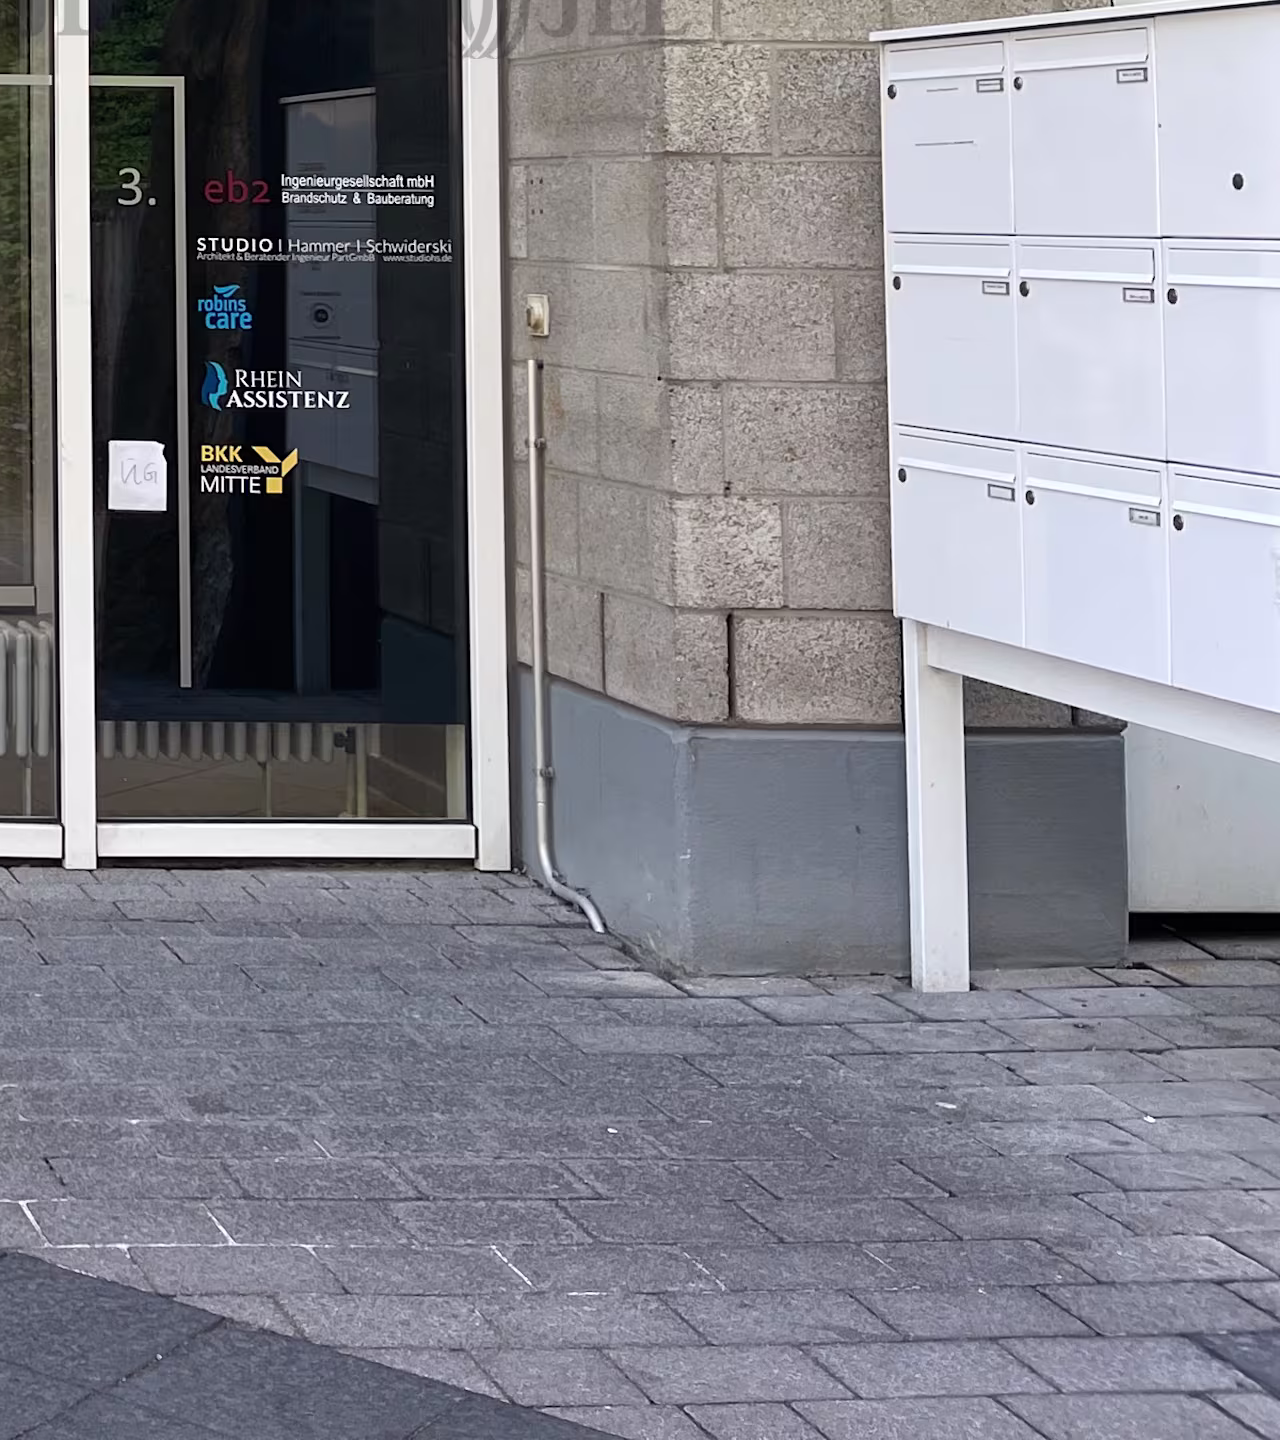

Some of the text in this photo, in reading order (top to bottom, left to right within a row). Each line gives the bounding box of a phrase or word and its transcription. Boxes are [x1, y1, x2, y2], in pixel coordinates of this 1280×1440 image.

[117, 166, 157, 207] 3.
[203, 170, 271, 204] eb2
[280, 173, 435, 190] Ingenieurgesellschaft mbH
[281, 192, 435, 208] Brandschutz & Bauberatung
[196, 237, 273, 253] STUDIO
[288, 238, 350, 253] Hammer
[365, 238, 453, 254] Schwiderski
[196, 253, 235, 262] Architekt
[197, 295, 247, 312] robins
[205, 311, 253, 330] care
[235, 368, 302, 389] RHEIN
[225, 389, 351, 409] ASSISTENZ
[200, 445, 243, 463] BKK
[200, 463, 279, 475] LANDESVERBAND
[200, 476, 262, 494] MITTE
